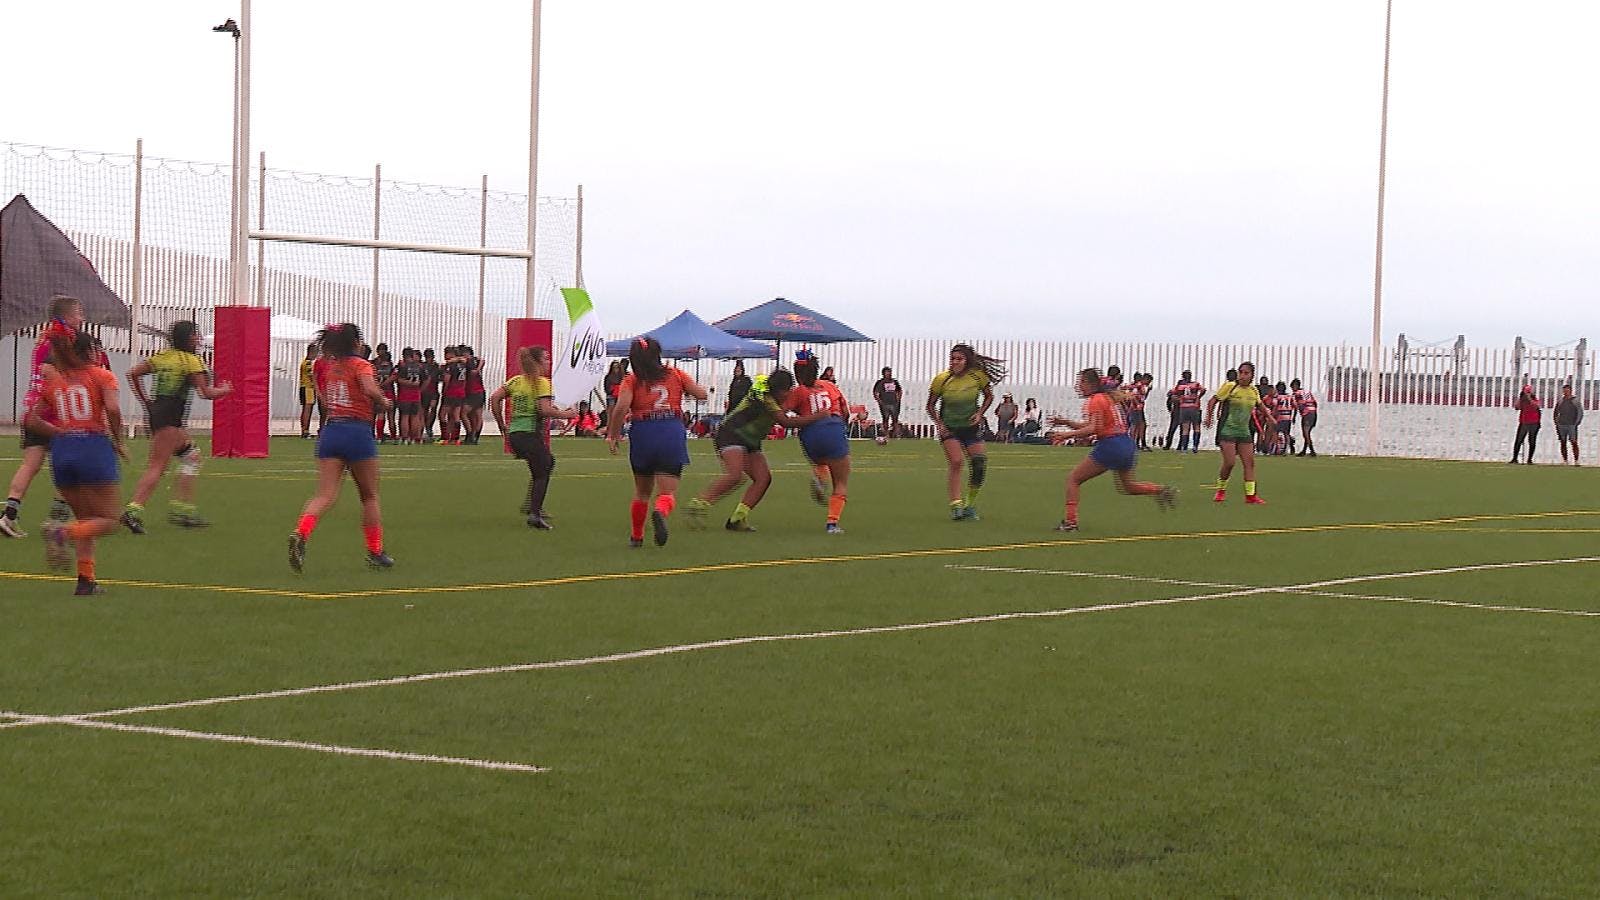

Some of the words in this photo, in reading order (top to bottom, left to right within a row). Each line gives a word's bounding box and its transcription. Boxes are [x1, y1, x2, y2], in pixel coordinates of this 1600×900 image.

[54, 385, 92, 422] 10
[650, 385, 671, 410] 2
[809, 391, 832, 415] 16
